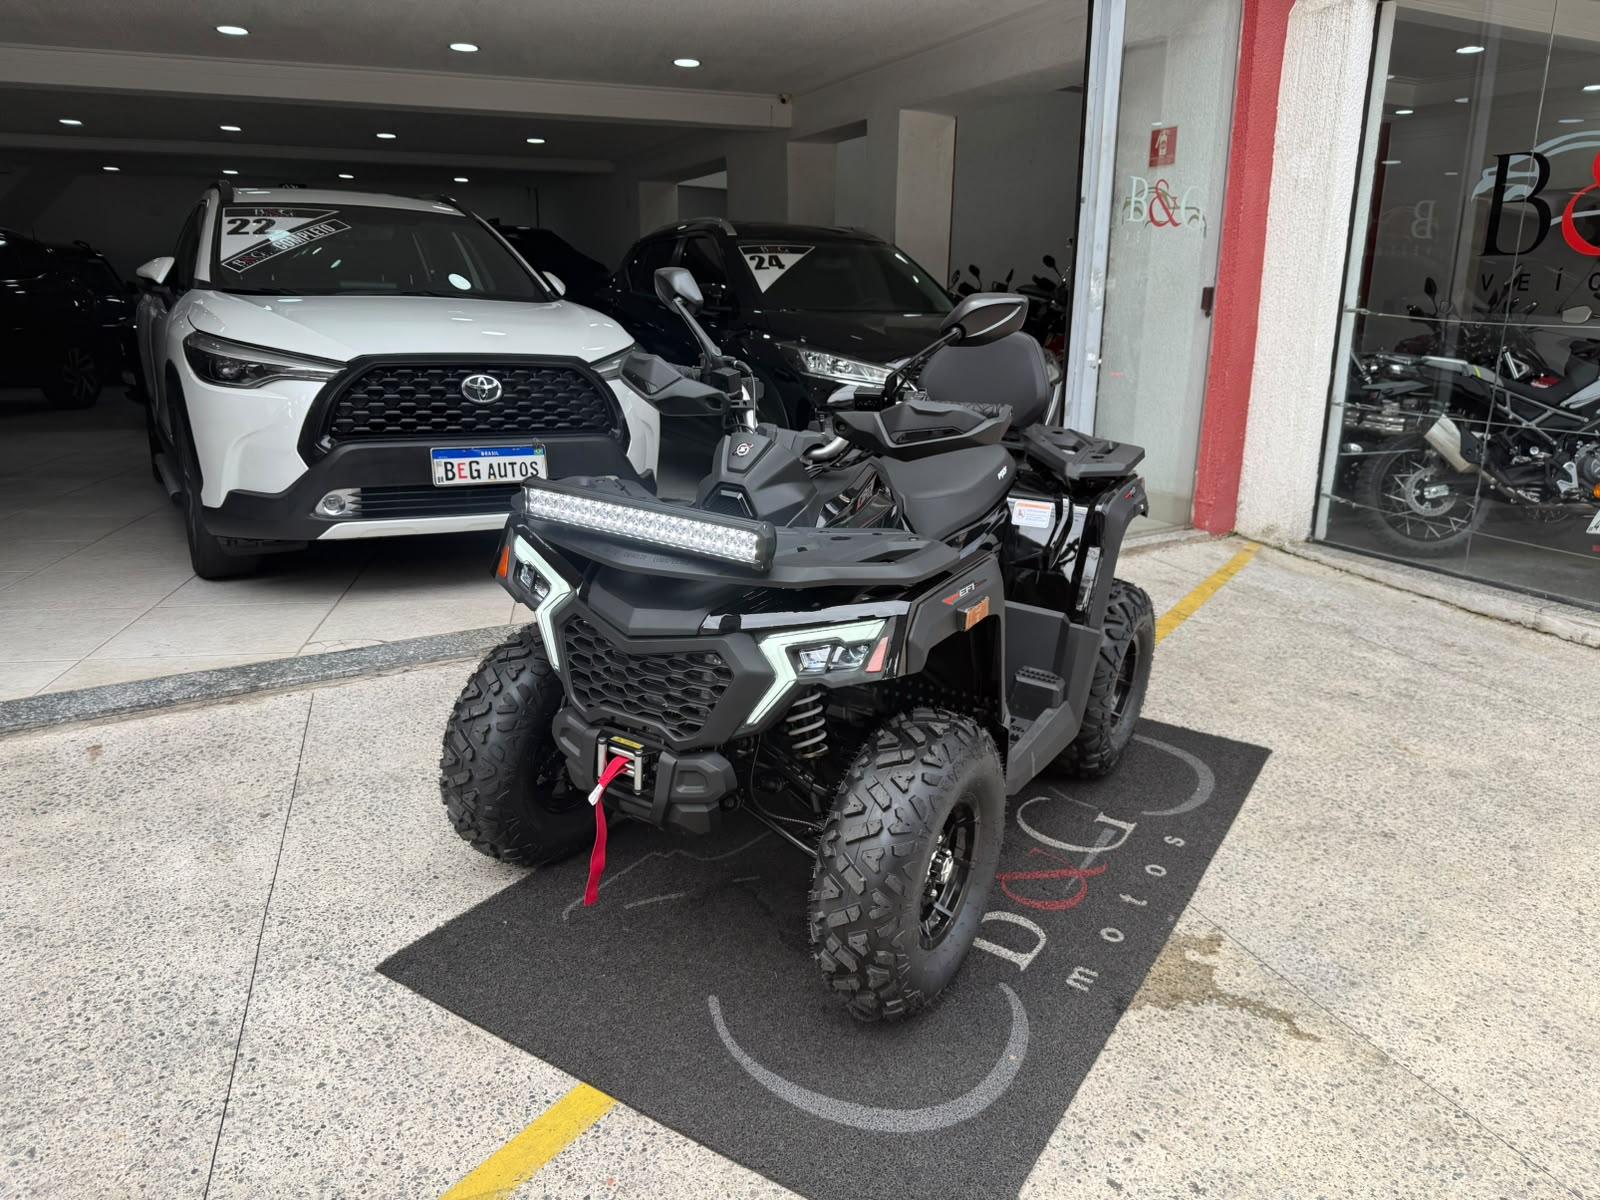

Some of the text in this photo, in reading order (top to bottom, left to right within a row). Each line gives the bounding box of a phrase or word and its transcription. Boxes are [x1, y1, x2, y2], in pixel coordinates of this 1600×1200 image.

[226, 218, 276, 235] 22
[272, 223, 336, 250] COMPLETO
[749, 255, 785, 270] 24
[444, 460, 480, 481] BEG
[488, 461, 539, 480] AUTOS
[1066, 835, 1185, 992] motos
